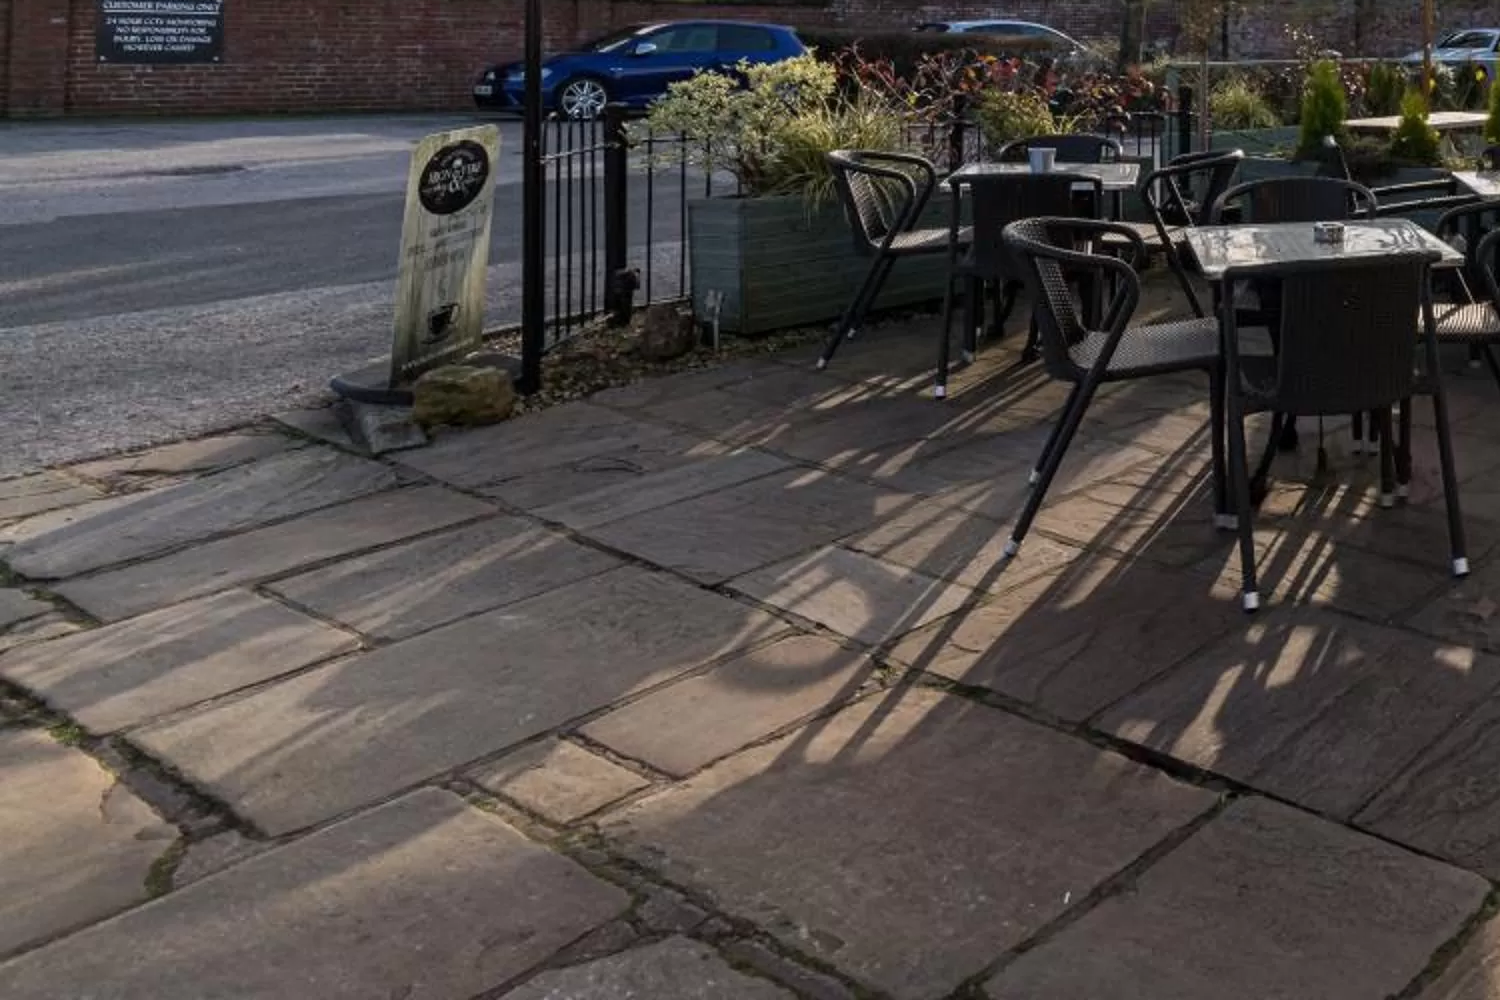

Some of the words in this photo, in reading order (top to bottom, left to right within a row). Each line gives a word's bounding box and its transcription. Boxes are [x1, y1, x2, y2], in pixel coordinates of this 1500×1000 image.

[103, 1, 153, 9] CUSTOMER
[155, 2, 195, 11] PARKING
[196, 3, 220, 12] ONLY
[106, 17, 117, 25] 24
[118, 17, 142, 25] HOUR
[144, 17, 164, 25] CCTV
